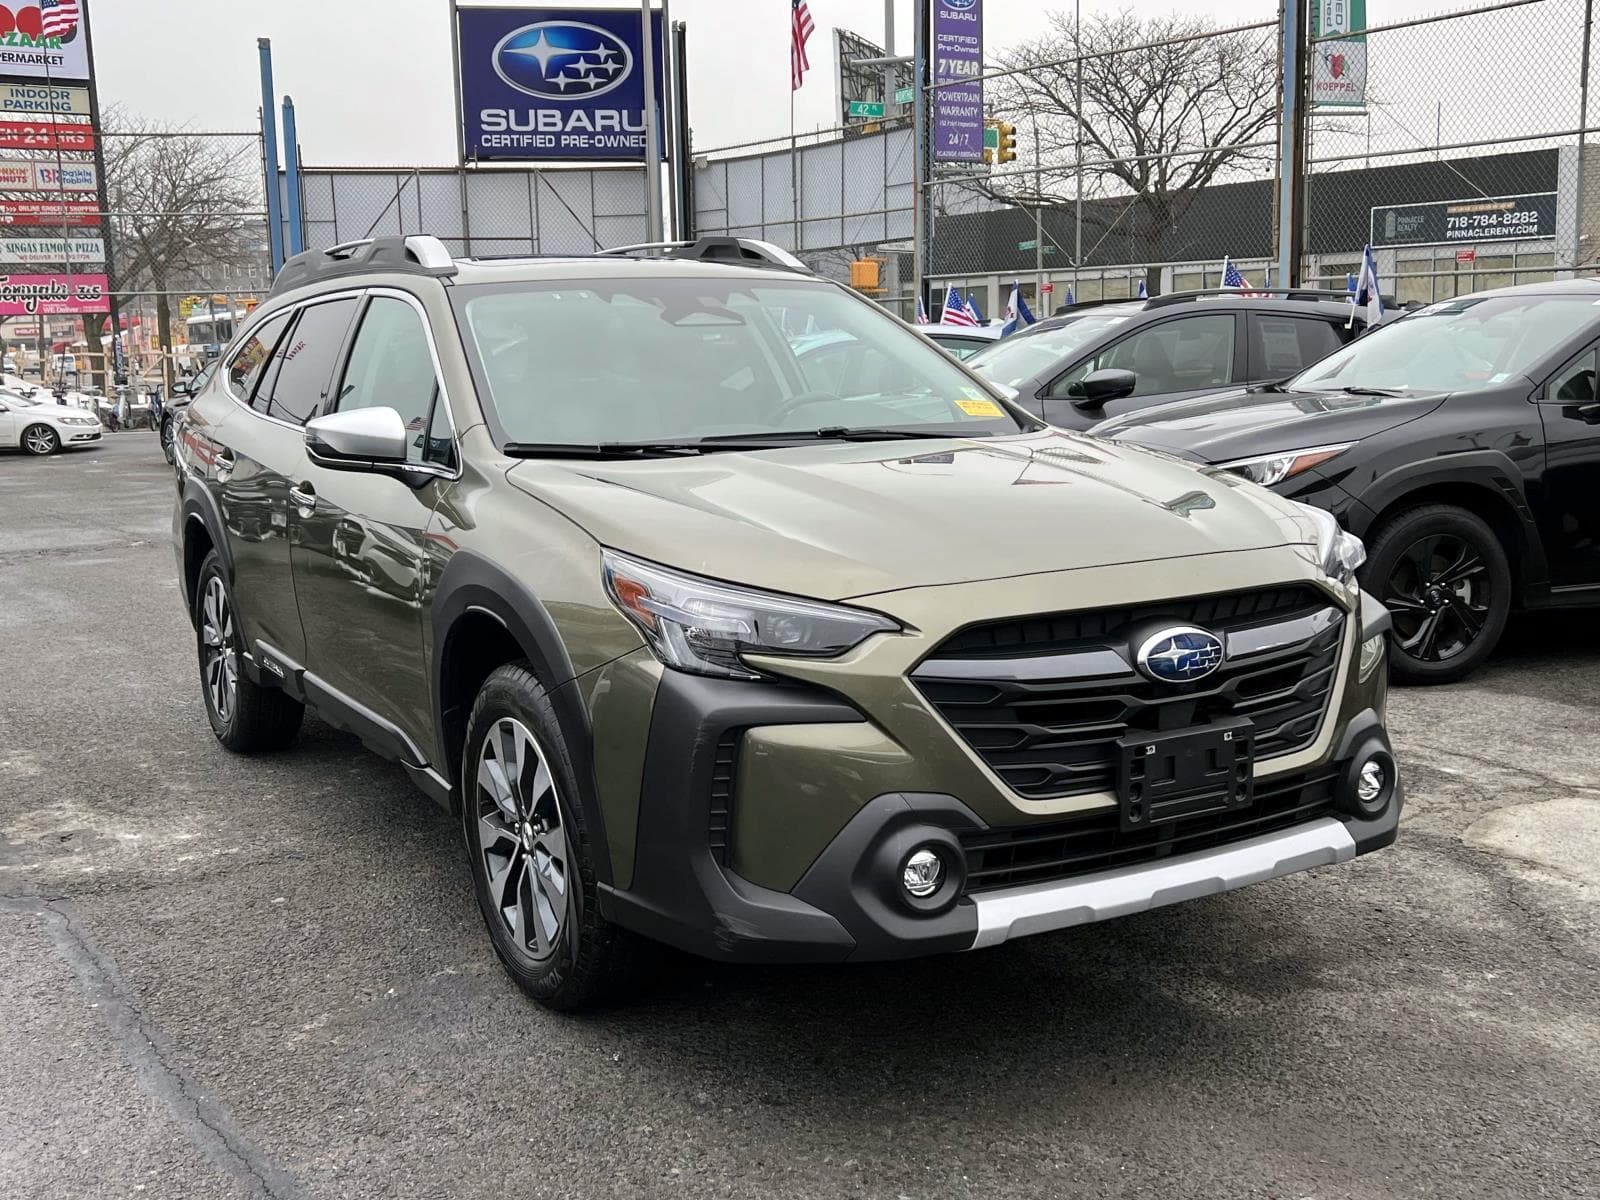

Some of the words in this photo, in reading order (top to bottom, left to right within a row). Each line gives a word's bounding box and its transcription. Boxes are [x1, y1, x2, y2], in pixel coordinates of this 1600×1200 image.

[940, 10, 977, 21] SUBARU
[0, 32, 63, 50] ZAAR
[937, 34, 978, 44] CERTIFIED
[937, 43, 979, 54] Pre-Owned
[939, 59, 946, 73] 7
[949, 60, 979, 76] YEAR
[1315, 82, 1358, 91] KOEPPEL
[10, 88, 70, 100] INDOOR
[937, 91, 980, 103] POWERTRAIN
[4, 99, 71, 111] PARKING
[857, 104, 869, 115] 42
[939, 106, 978, 117] WARRANTY
[480, 108, 648, 132] SUBARU
[24, 128, 49, 144] 24
[481, 134, 556, 148] CERTIFIED
[561, 134, 648, 149] PRE-OWNED
[1446, 211, 1538, 228] 718-784-8282
[1446, 225, 1538, 239] PINNACLERENY.COM
[6, 242, 37, 253] SINGAS
[75, 242, 100, 253] PIZZA
